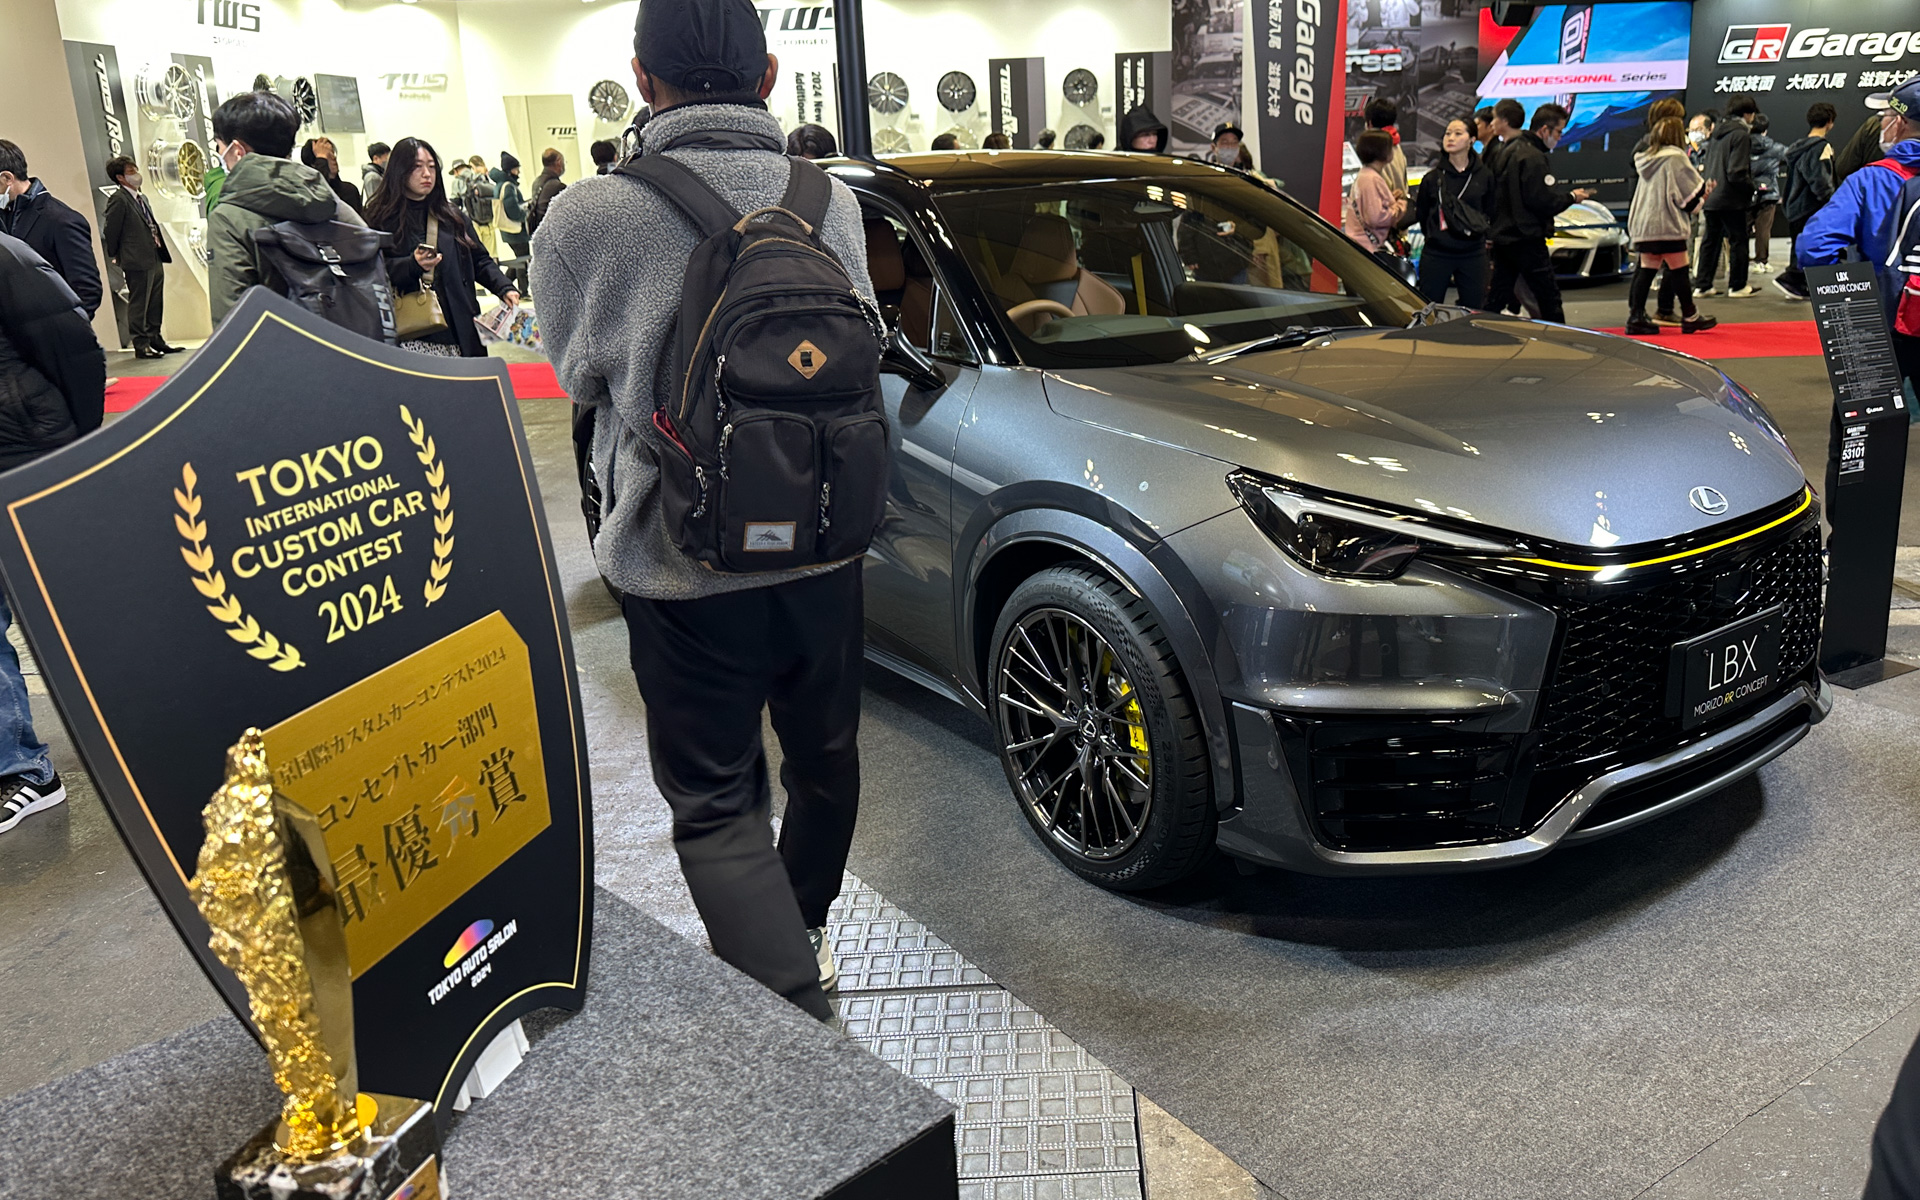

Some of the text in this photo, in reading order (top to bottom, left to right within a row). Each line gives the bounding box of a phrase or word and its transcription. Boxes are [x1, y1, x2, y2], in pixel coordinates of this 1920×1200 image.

[1503, 70, 1667, 86] PROFESSIONAL Series
[1722, 38, 1783, 60] GR
[811, 71, 823, 123] 2024 New
[1785, 72, 1847, 90] 大阪八尾
[1817, 285, 1839, 295] MORIZO
[1847, 282, 1871, 292] CONCEPT
[236, 435, 383, 507] TOKYO
[1842, 446, 1865, 461] 53101
[232, 490, 427, 578] CUSTOM CAR
[245, 474, 400, 538] INTERNATIONAL
[282, 531, 403, 597] CONTEST
[318, 575, 403, 643] 2024
[1709, 634, 1758, 691] LBX
[271, 645, 507, 789] 京国際カスタムカーコンテスト2024
[1693, 674, 1769, 717] MORIZO RR CONCEPT
[316, 702, 498, 833] コンセプトカー部門
[331, 747, 527, 928] 最優秀賞
[427, 918, 517, 1005] TOKYO AUTO SALON
[471, 962, 491, 987] 2024
